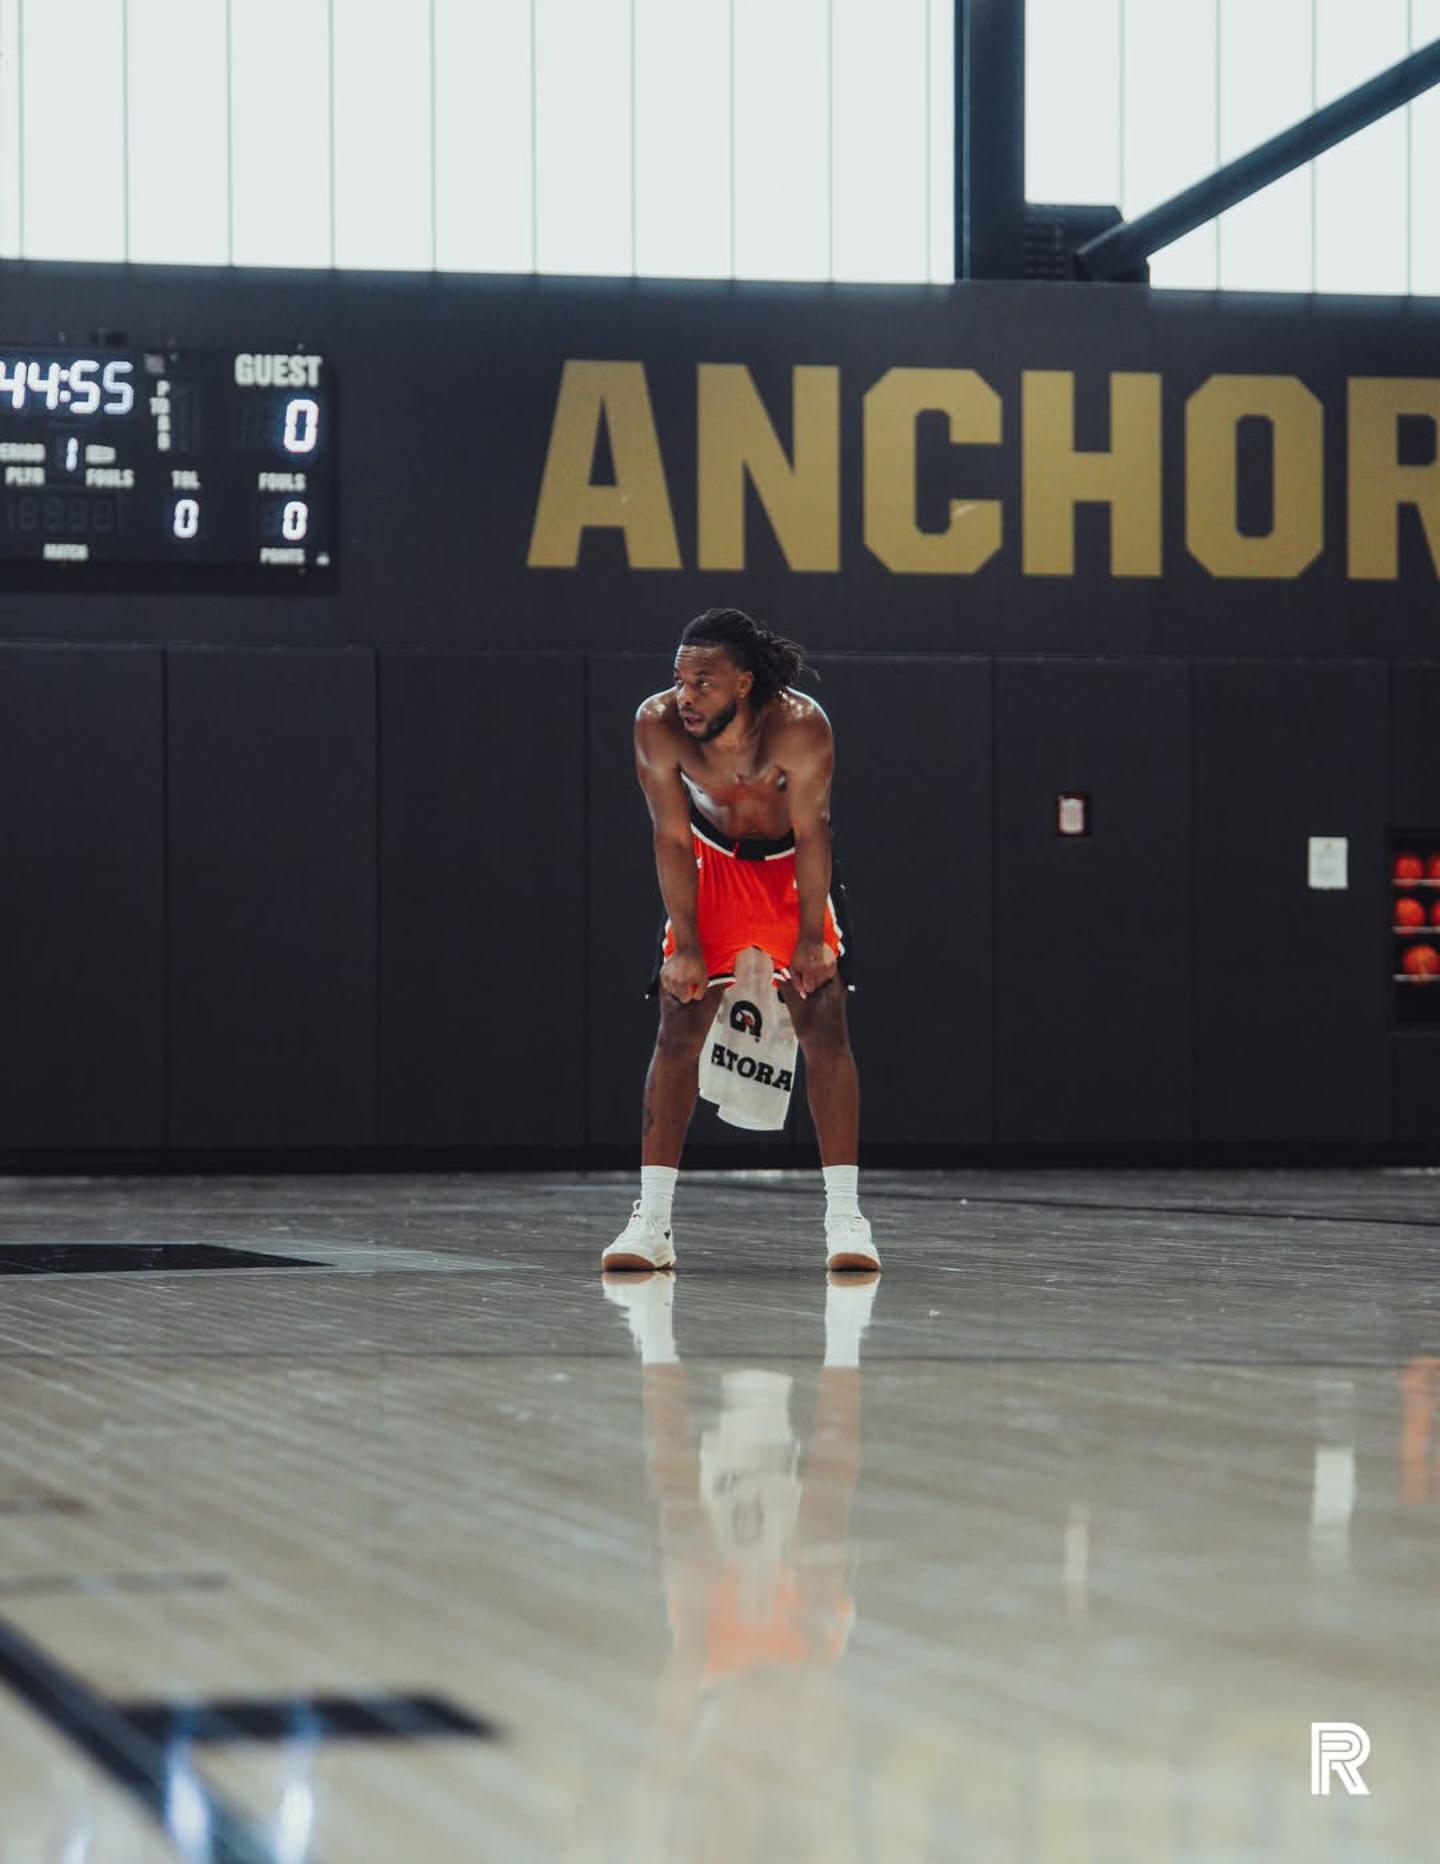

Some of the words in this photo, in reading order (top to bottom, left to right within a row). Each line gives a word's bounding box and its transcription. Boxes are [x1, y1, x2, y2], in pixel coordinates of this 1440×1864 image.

[0, 360, 134, 415] 44:55
[235, 354, 322, 387] GUEST
[283, 399, 319, 453] 0
[526, 359, 1440, 580] ANCHOR
[173, 499, 200, 539] 0
[282, 501, 309, 540] 0
[711, 1043, 792, 1091] ATORA
